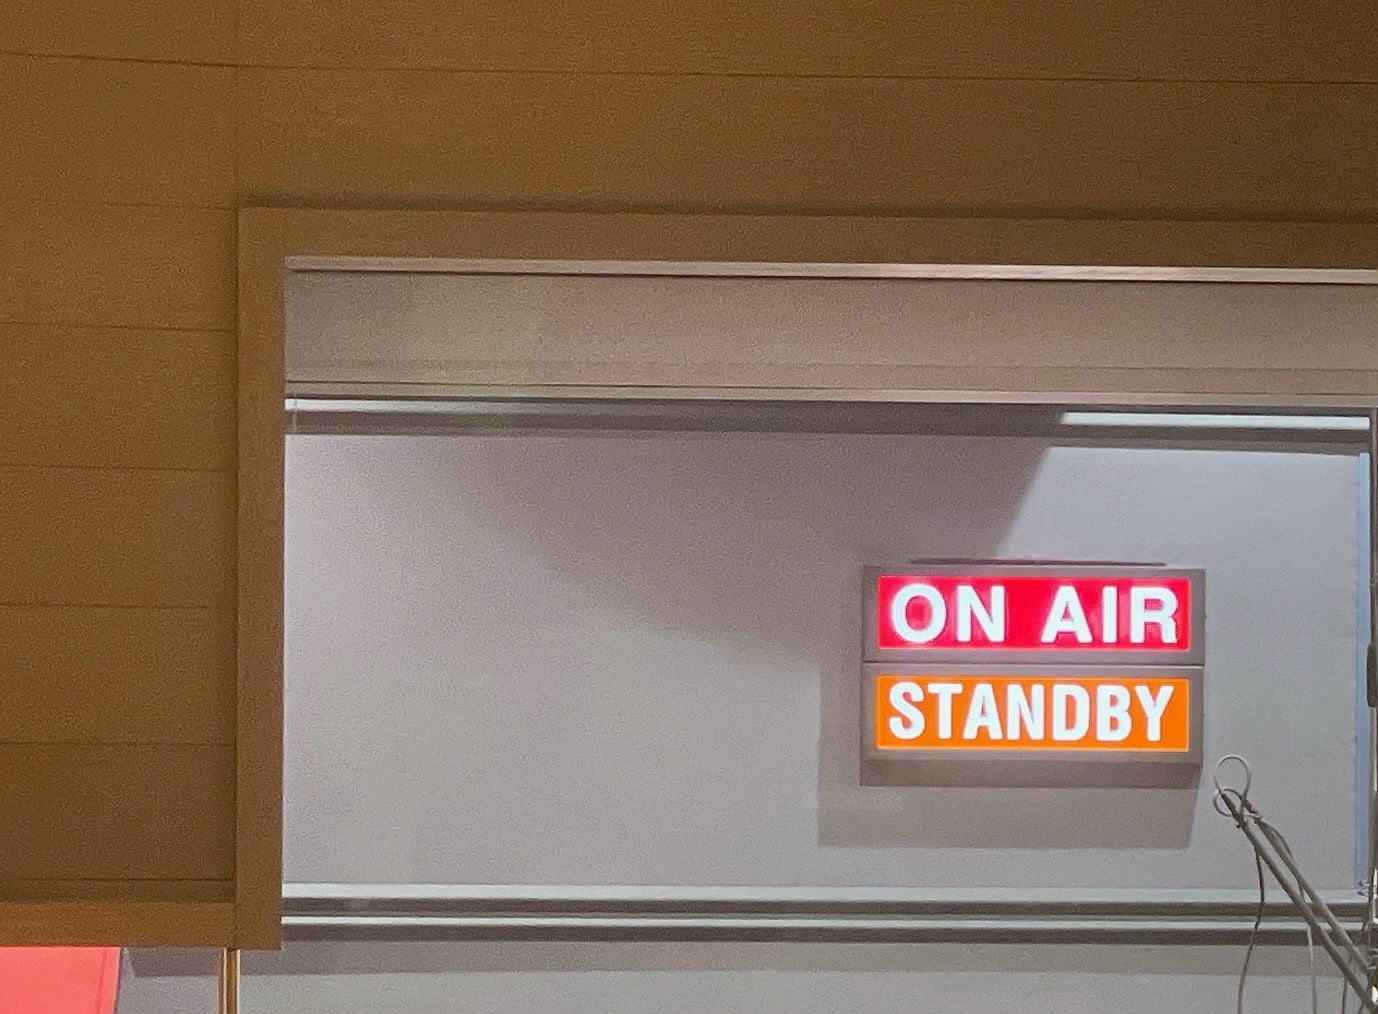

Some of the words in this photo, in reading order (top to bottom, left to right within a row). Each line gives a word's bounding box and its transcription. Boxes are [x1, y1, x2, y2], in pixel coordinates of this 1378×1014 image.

[890, 583, 1006, 643] ON
[1040, 585, 1179, 644] AIR
[888, 681, 1176, 742] STANDBY
